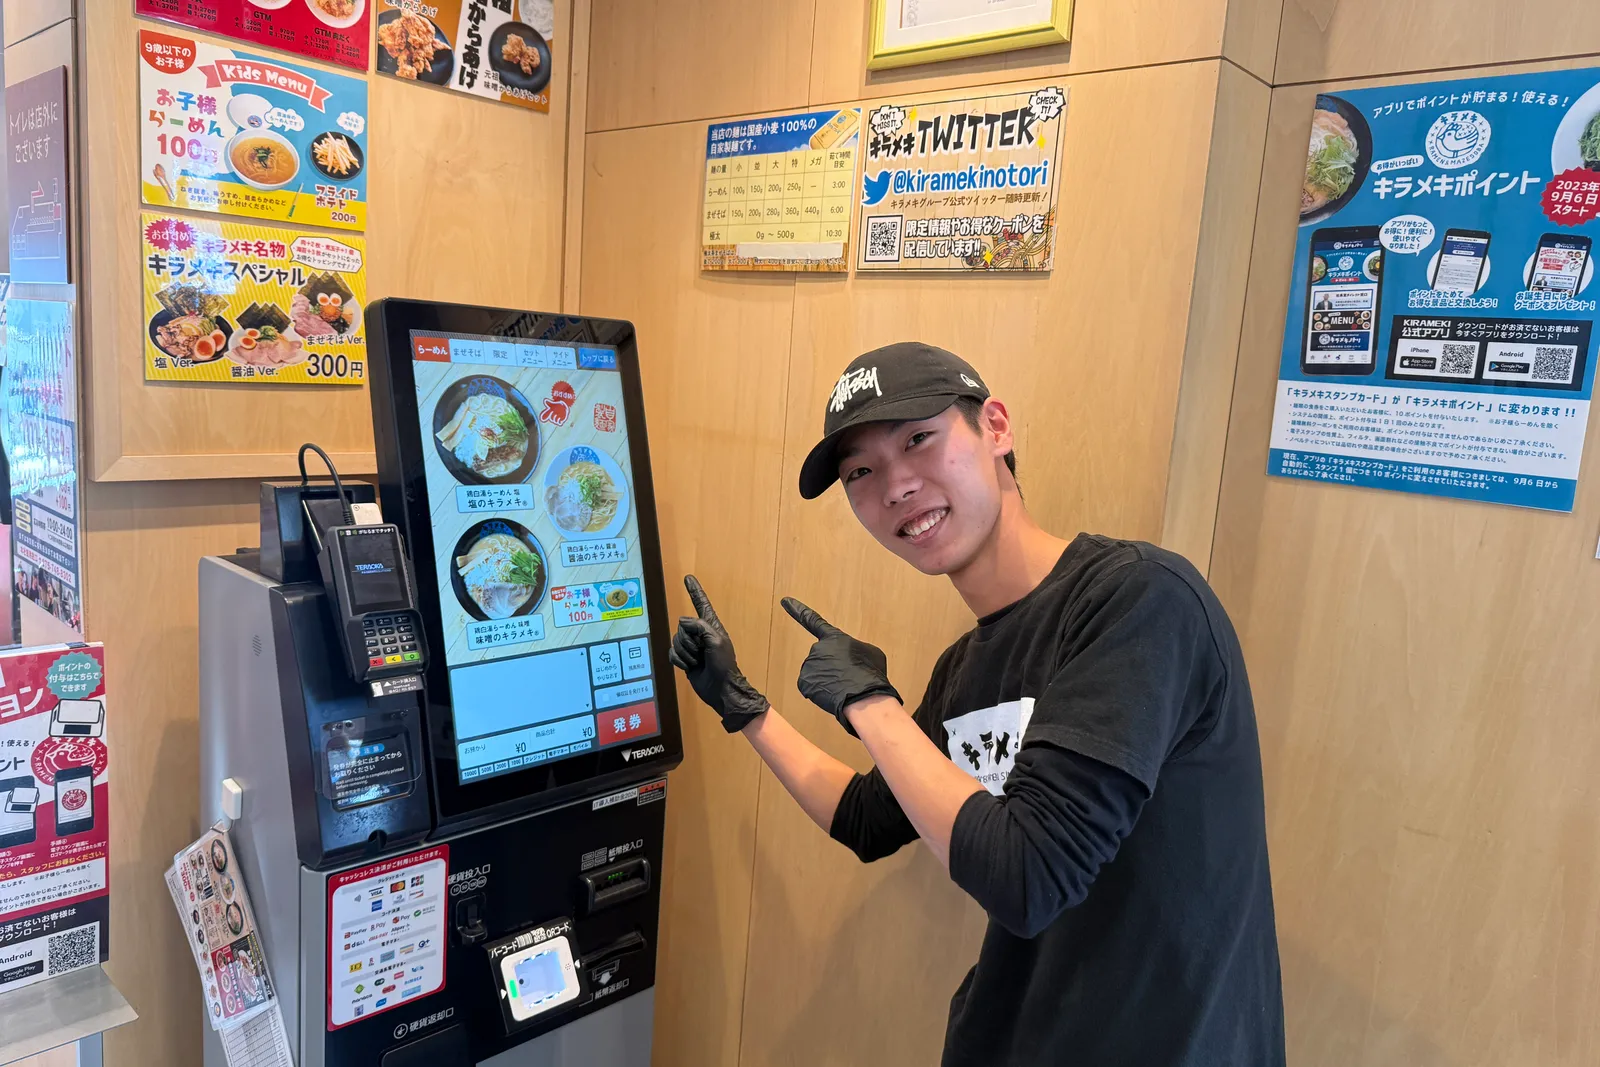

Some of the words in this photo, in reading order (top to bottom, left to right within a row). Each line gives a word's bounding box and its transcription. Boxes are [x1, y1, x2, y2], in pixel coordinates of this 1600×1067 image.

[253, 11, 272, 22] GTM
[314, 27, 332, 39] GTM
[145, 42, 192, 57] 9歳以下の
[155, 56, 185, 69] お子様
[221, 63, 262, 80] Kids
[265, 69, 308, 94] Menu
[156, 88, 218, 117] お子様
[1035, 95, 1059, 106] CHECK
[1040, 103, 1052, 114] IT!
[9, 102, 58, 136] トイレは店外に
[148, 109, 226, 139] らーめん
[1440, 112, 1478, 124] キラメキ
[869, 132, 915, 158] キラメキ
[917, 106, 1036, 154] TWITTER
[15, 134, 51, 163] ございます
[710, 138, 757, 155] 自家製麺です。
[736, 163, 743, 172] 小
[754, 161, 761, 170] 並
[772, 159, 779, 168] 大
[791, 158, 798, 167] 特
[809, 156, 822, 166] メガ
[833, 160, 845, 168] 目安
[1376, 157, 1419, 170] お得がいっぱい
[893, 160, 1049, 193] @kiramekinotori
[708, 187, 728, 197] らーめん
[732, 186, 745, 195] 100g
[750, 185, 763, 194] 150g
[768, 184, 782, 193] 200g
[787, 182, 802, 192] 250g
[832, 180, 846, 188] 3:00
[1372, 169, 1542, 200] キラメキポイント
[1555, 180, 1600, 193] 2023年
[315, 184, 358, 200] フライド
[1551, 191, 1599, 206] 9月6日
[315, 195, 347, 209] ポテト
[331, 211, 357, 223] 200円
[706, 208, 726, 220] まぜそば
[731, 209, 744, 218] 150g
[749, 208, 762, 217] 200g
[766, 207, 780, 217] 280g
[785, 207, 800, 216] 360g
[804, 206, 820, 215] 440g
[830, 205, 844, 214] 6:00
[1551, 204, 1589, 217] スタート
[905, 213, 1045, 237] 限定情報やお得なクーポンを
[1390, 220, 1428, 228] アプリがもっと
[709, 231, 721, 240] 極太
[756, 231, 765, 240] 0g
[777, 230, 795, 239] 500g
[825, 229, 843, 237] 10:30
[201, 239, 286, 258] キラメキ名物
[148, 253, 306, 287] キラメキスペシャル
[1408, 289, 1464, 300] ポイントをためて
[1516, 291, 1569, 301] お誕生日には
[1331, 316, 1354, 325] MENU
[1403, 319, 1451, 328] KIRAMEKI
[1401, 327, 1450, 338] 公式アプリ
[1456, 322, 1580, 333] ダウンロードがお済でないお客様は
[306, 334, 346, 346] まぜそば
[347, 335, 365, 345] Ver.
[418, 344, 448, 356] らーめん
[453, 348, 482, 358] まぜそば
[492, 350, 508, 360] 限定
[524, 349, 540, 357] セット
[553, 351, 569, 359] サイド
[581, 353, 615, 364] トップに戻る
[1499, 350, 1525, 358] Android
[154, 356, 168, 370] 塩
[171, 357, 195, 368] Ver.
[306, 353, 364, 379] 300円
[231, 365, 255, 378] 醤油
[258, 365, 279, 376] Ver.
[466, 489, 512, 498] 鶏白湯らーめん
[566, 586, 591, 599] お子様
[564, 598, 595, 610] らーめん
[568, 610, 594, 623] 100円
[474, 622, 518, 635] 鶏白湯らーめん
[518, 620, 530, 628] 味噌
[58, 662, 91, 672] ポイントの
[595, 663, 617, 673] はじめから
[49, 672, 100, 683] 付与はこちらで
[596, 673, 618, 681] やりなおす
[61, 684, 88, 693] できます
[613, 713, 642, 734] 発券
[582, 726, 593, 738] ¥0
[464, 744, 486, 755] お預かり
[515, 742, 526, 754] ¥0
[631, 744, 665, 760] TERAOKA
[464, 769, 477, 777] 10000
[481, 766, 492, 774] 5000
[496, 762, 507, 770] 2000
[525, 752, 546, 763] クレジット
[573, 743, 589, 751] モバイル
[410, 1007, 454, 1031] 硬貨返却口
